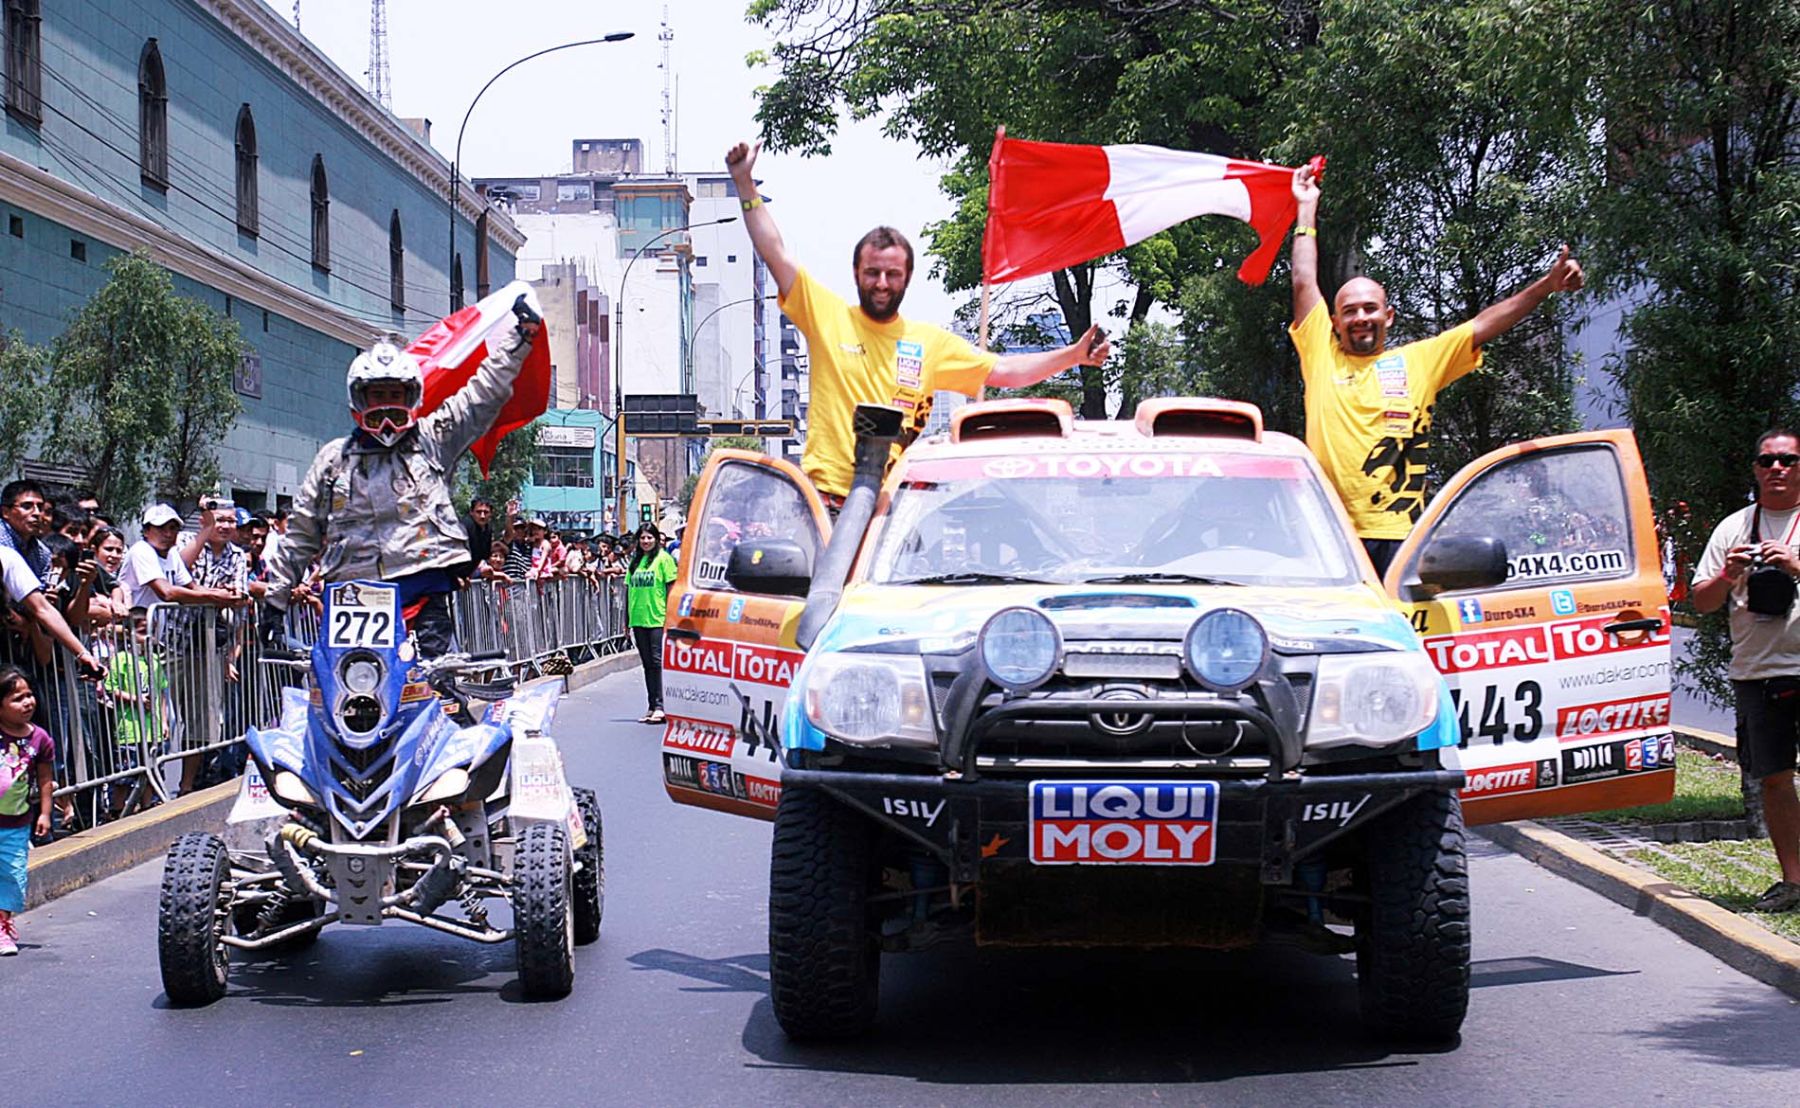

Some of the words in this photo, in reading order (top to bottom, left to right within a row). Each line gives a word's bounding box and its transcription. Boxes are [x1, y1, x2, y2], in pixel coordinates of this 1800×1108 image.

[1041, 456, 1225, 478] TOYOTA
[700, 561, 728, 581] Dur
[334, 610, 390, 645] 272
[1484, 605, 1536, 622] Duro4X4
[1426, 635, 1549, 671] TOTAL
[1552, 621, 1670, 655] TOTL
[667, 639, 731, 674] TOTAL
[1559, 659, 1670, 690] www.dakar.com
[665, 685, 730, 705] www.dakar.com
[741, 695, 782, 763] 44
[1449, 679, 1543, 751] 443
[1562, 697, 1670, 738] LOCTITE
[667, 720, 731, 752] LOCTITE
[749, 781, 782, 801] LOCTI
[1461, 768, 1531, 794] LOCTITE
[1042, 785, 1206, 820] LIQUI
[1042, 822, 1209, 859] MOLY
